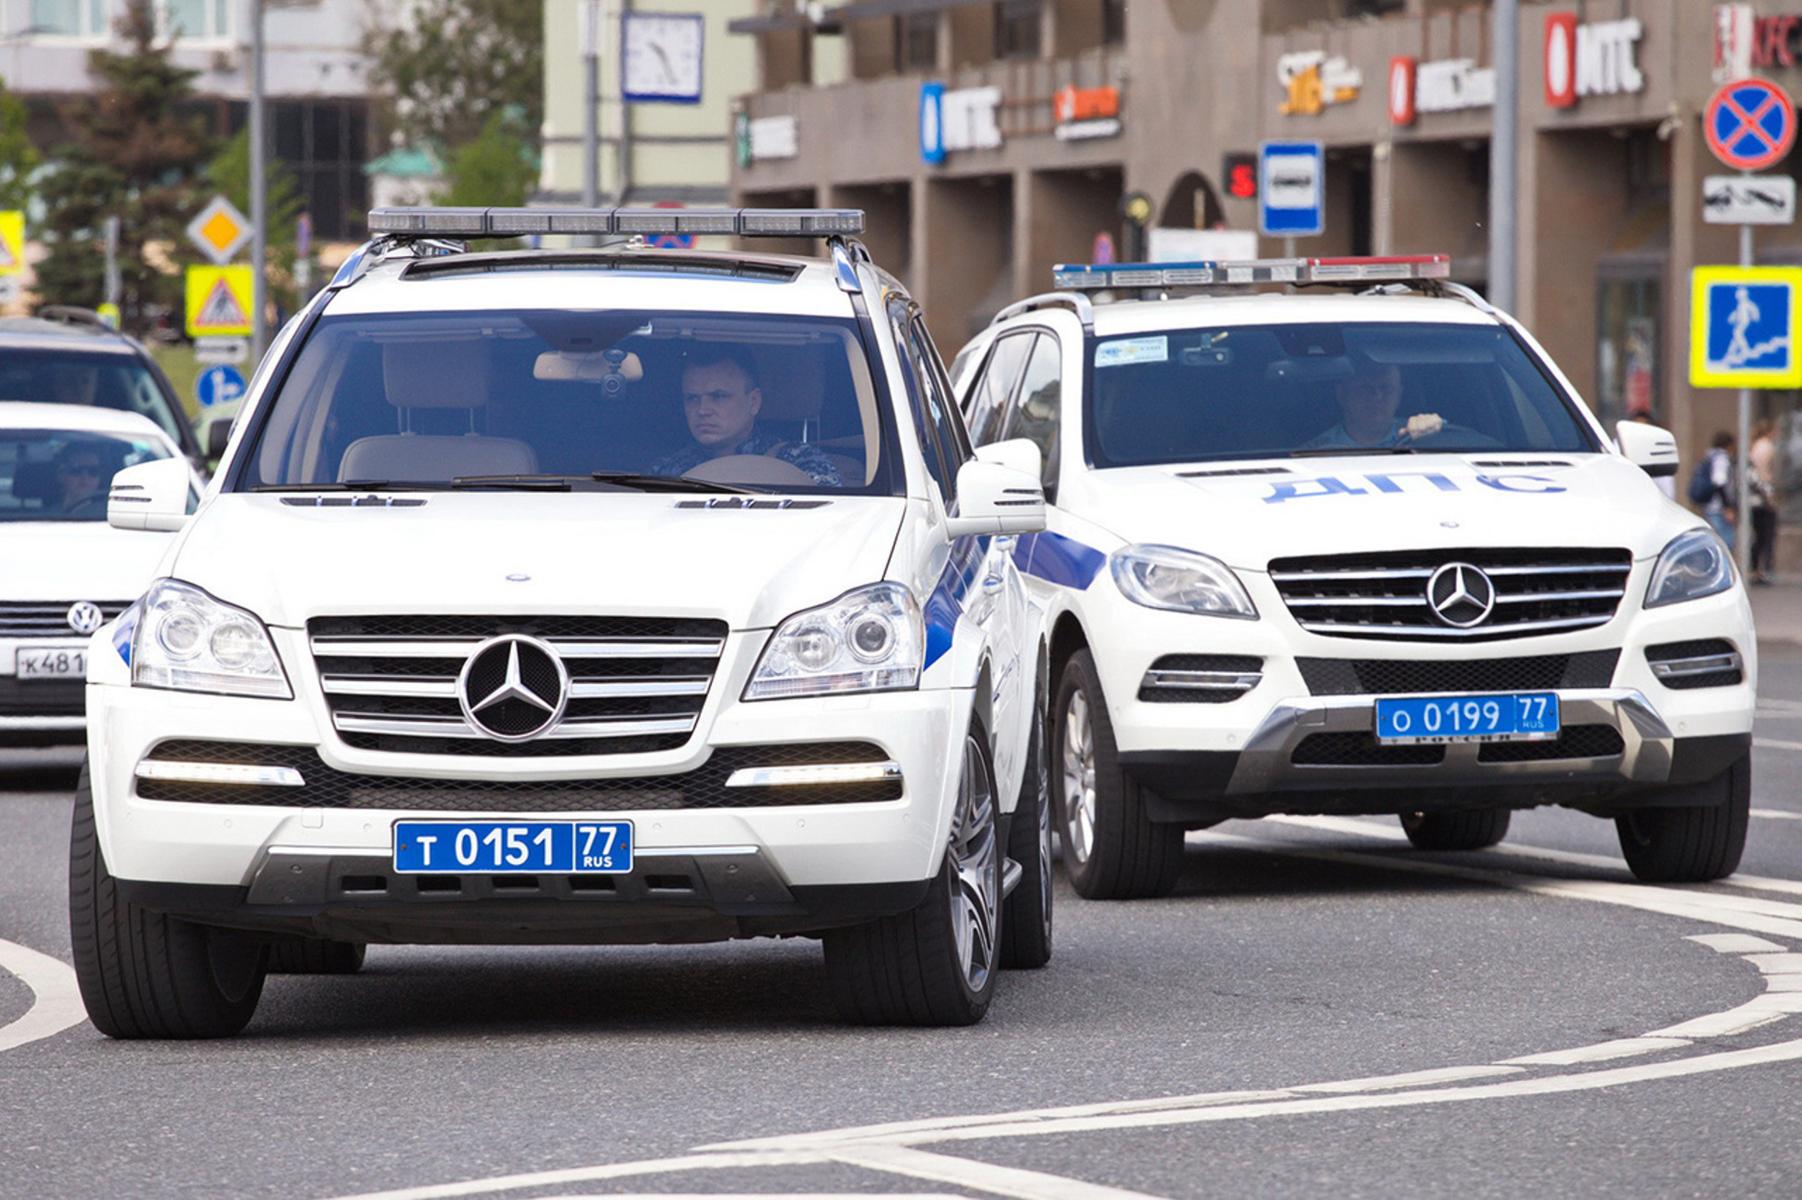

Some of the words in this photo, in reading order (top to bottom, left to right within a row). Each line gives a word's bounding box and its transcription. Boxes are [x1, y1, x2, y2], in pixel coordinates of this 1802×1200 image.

[1262, 472, 1568, 504] ДПС
[26, 653, 87, 674] К481
[1423, 701, 1500, 732] 0199
[1519, 698, 1548, 721] 77
[1522, 720, 1545, 729] RUS
[416, 835, 438, 866] Т
[455, 827, 553, 866] 0151
[579, 826, 617, 856] 77
[583, 856, 613, 868] RUS
